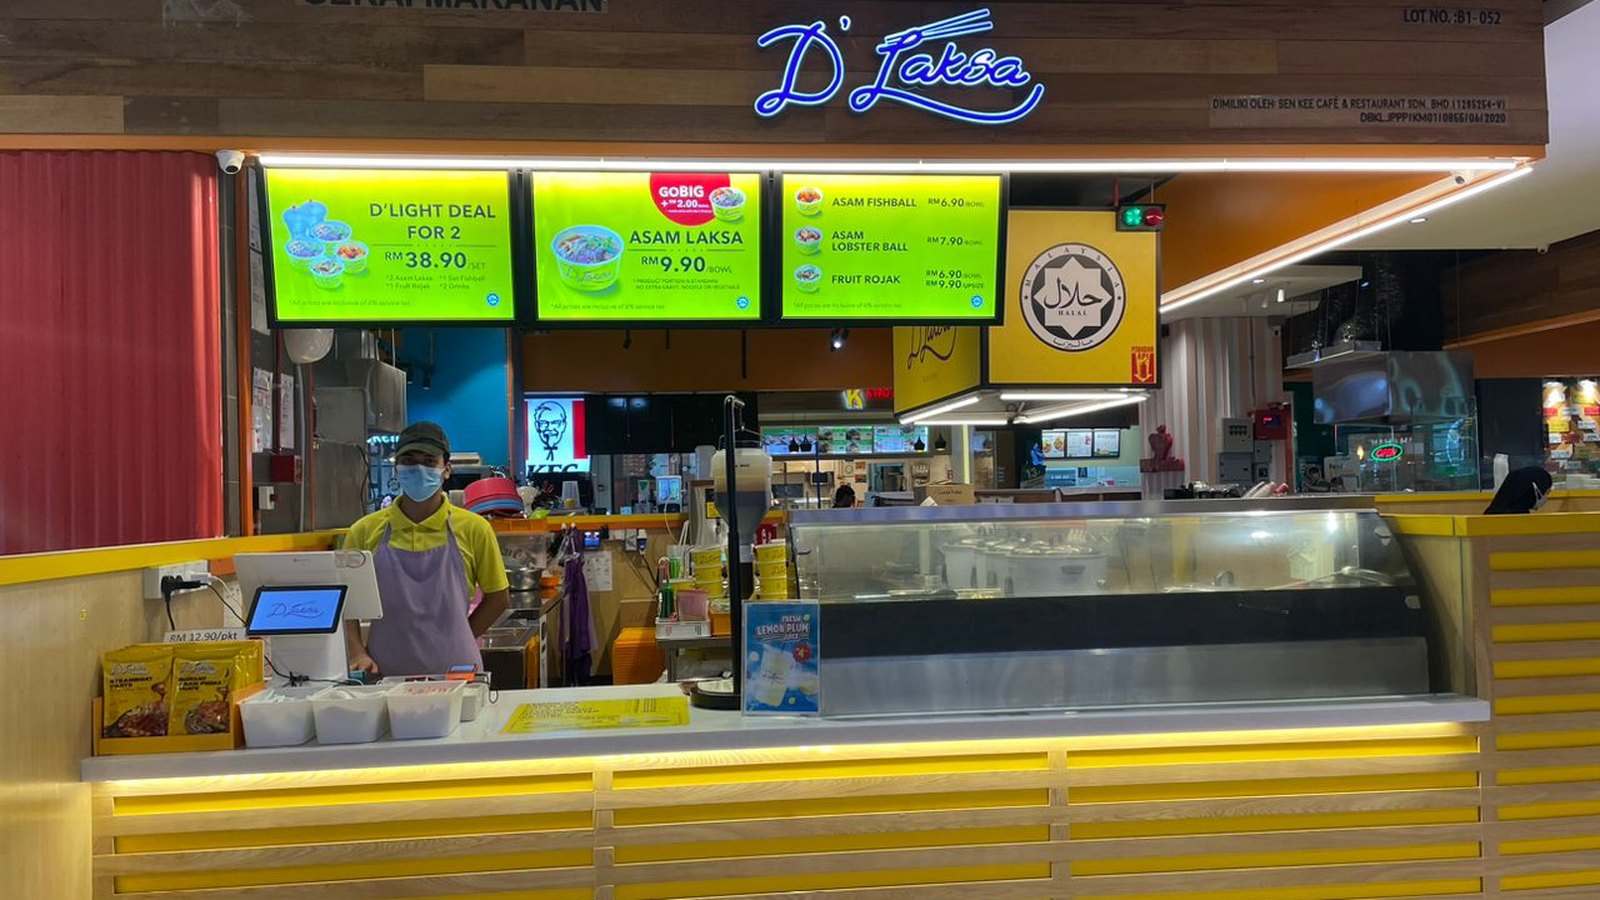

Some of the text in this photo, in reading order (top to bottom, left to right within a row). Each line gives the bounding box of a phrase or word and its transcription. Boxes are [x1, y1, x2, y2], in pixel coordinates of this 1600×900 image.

[1403, 9, 1426, 22] LOT
[1429, 9, 1451, 23] NO.
[1213, 98, 1248, 109] DIMILIKI
[1279, 98, 1296, 109] SEN
[1298, 98, 1315, 109] KEE
[1341, 98, 1349, 109] &
[1350, 98, 1406, 109] RESTAURANT
[658, 185, 705, 198] GOBIG
[831, 198, 918, 208] ASAM FISHBALL
[369, 203, 496, 218] D'LIGHT DEAL
[407, 225, 461, 240] FOR 2
[629, 230, 743, 244] ASAM LAKSA
[831, 231, 864, 240] ASAM
[831, 242, 909, 252] LOBSTER BALL
[1026, 246, 1121, 288] MALAYSIA
[831, 275, 901, 285] FRUIT ROJAK
[1043, 276, 1104, 310] حلال
[756, 622, 810, 636] LEMON PLUM
[169, 634, 186, 642] RM
